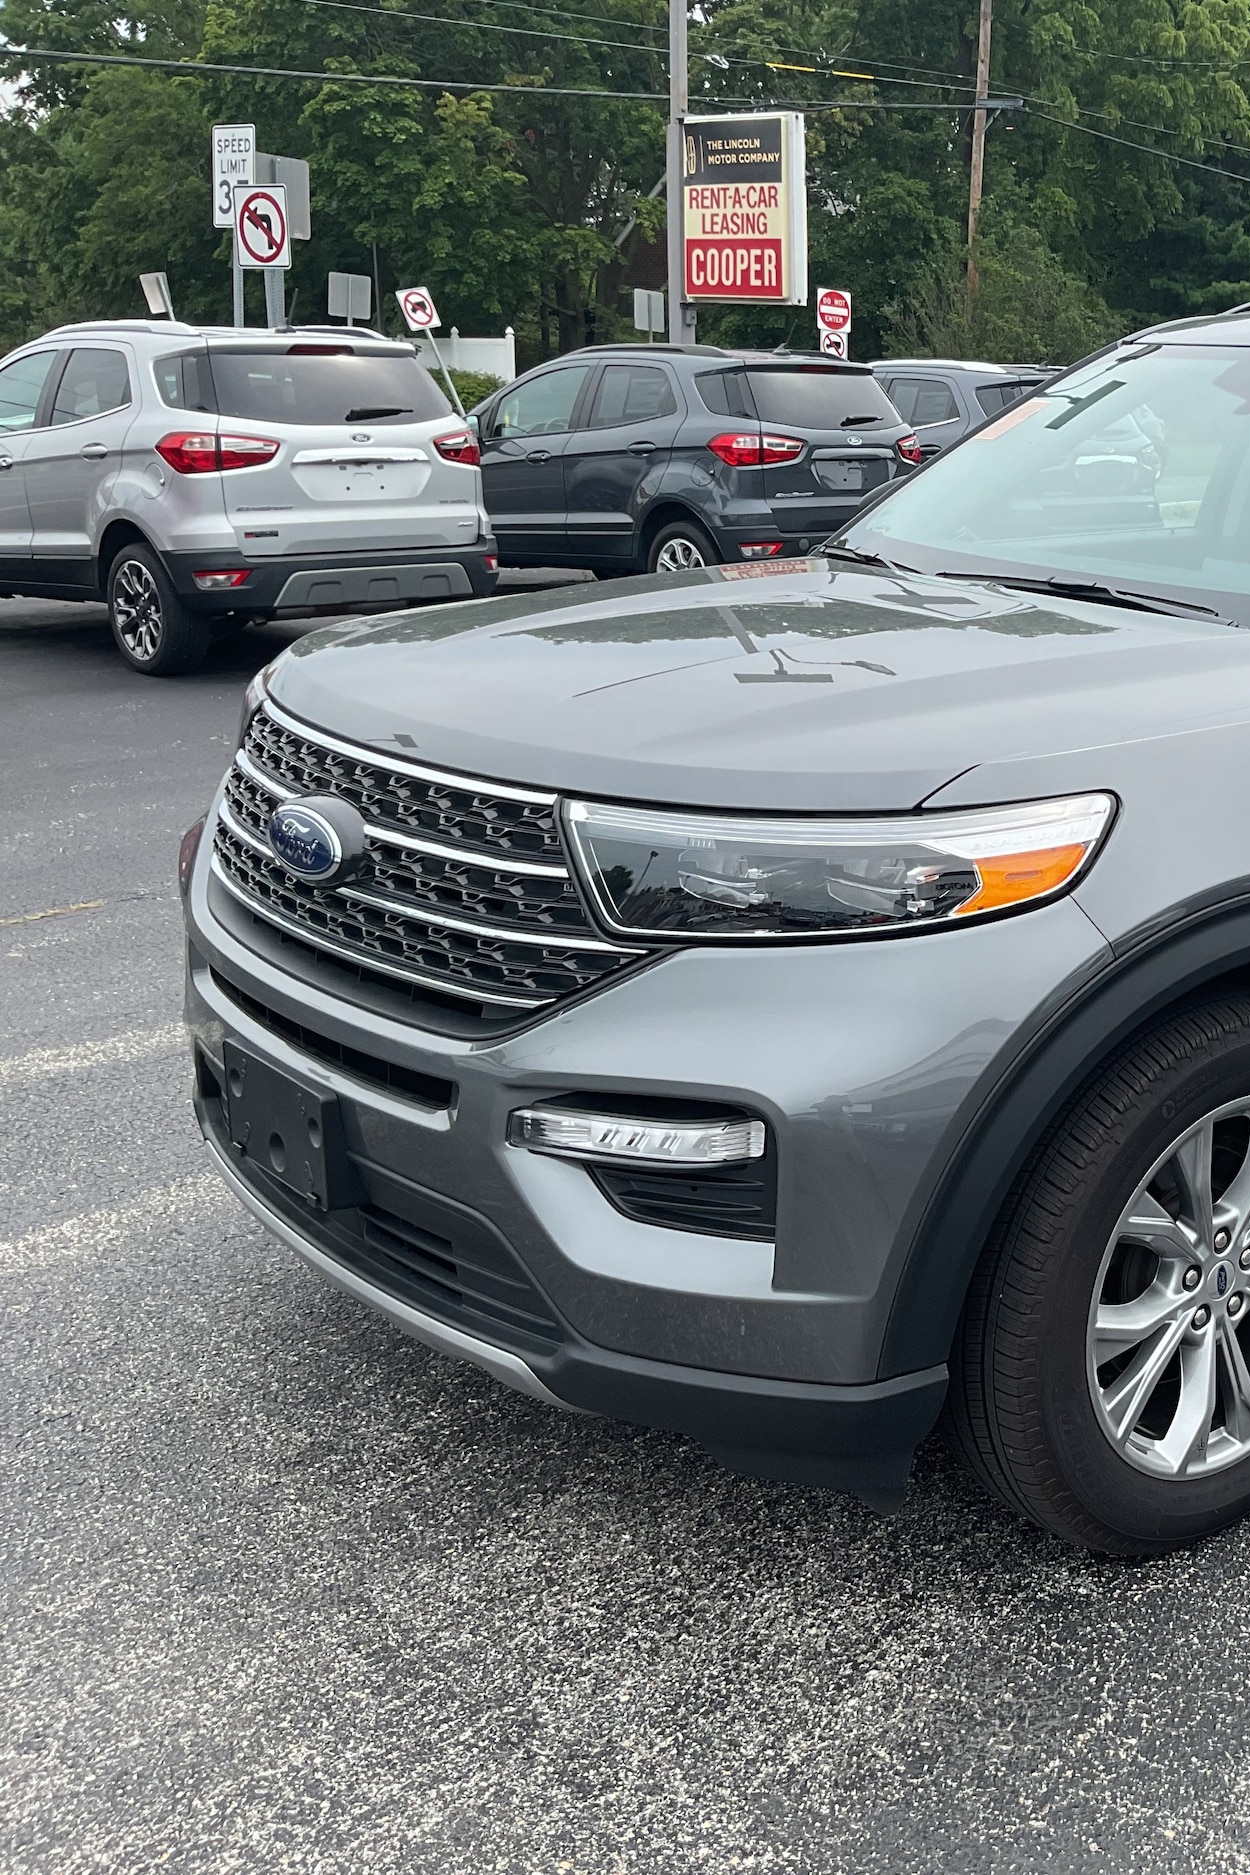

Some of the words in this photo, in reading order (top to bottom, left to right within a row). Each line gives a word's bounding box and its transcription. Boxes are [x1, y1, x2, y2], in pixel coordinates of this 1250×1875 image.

[217, 138, 251, 153] SPEED
[707, 140, 723, 150] THE
[724, 138, 760, 149] LINCOLN
[708, 154, 737, 165] MOTOR
[739, 152, 780, 163] COMPANY
[220, 159, 247, 174] LIMIT
[689, 185, 779, 209] RENT-A-CAR
[701, 212, 768, 235] LEASING
[691, 248, 777, 287] COOPER
[822, 296, 831, 305] DO
[833, 298, 846, 307] NOT
[825, 315, 844, 324] ENTER
[277, 818, 319, 866] Ford
